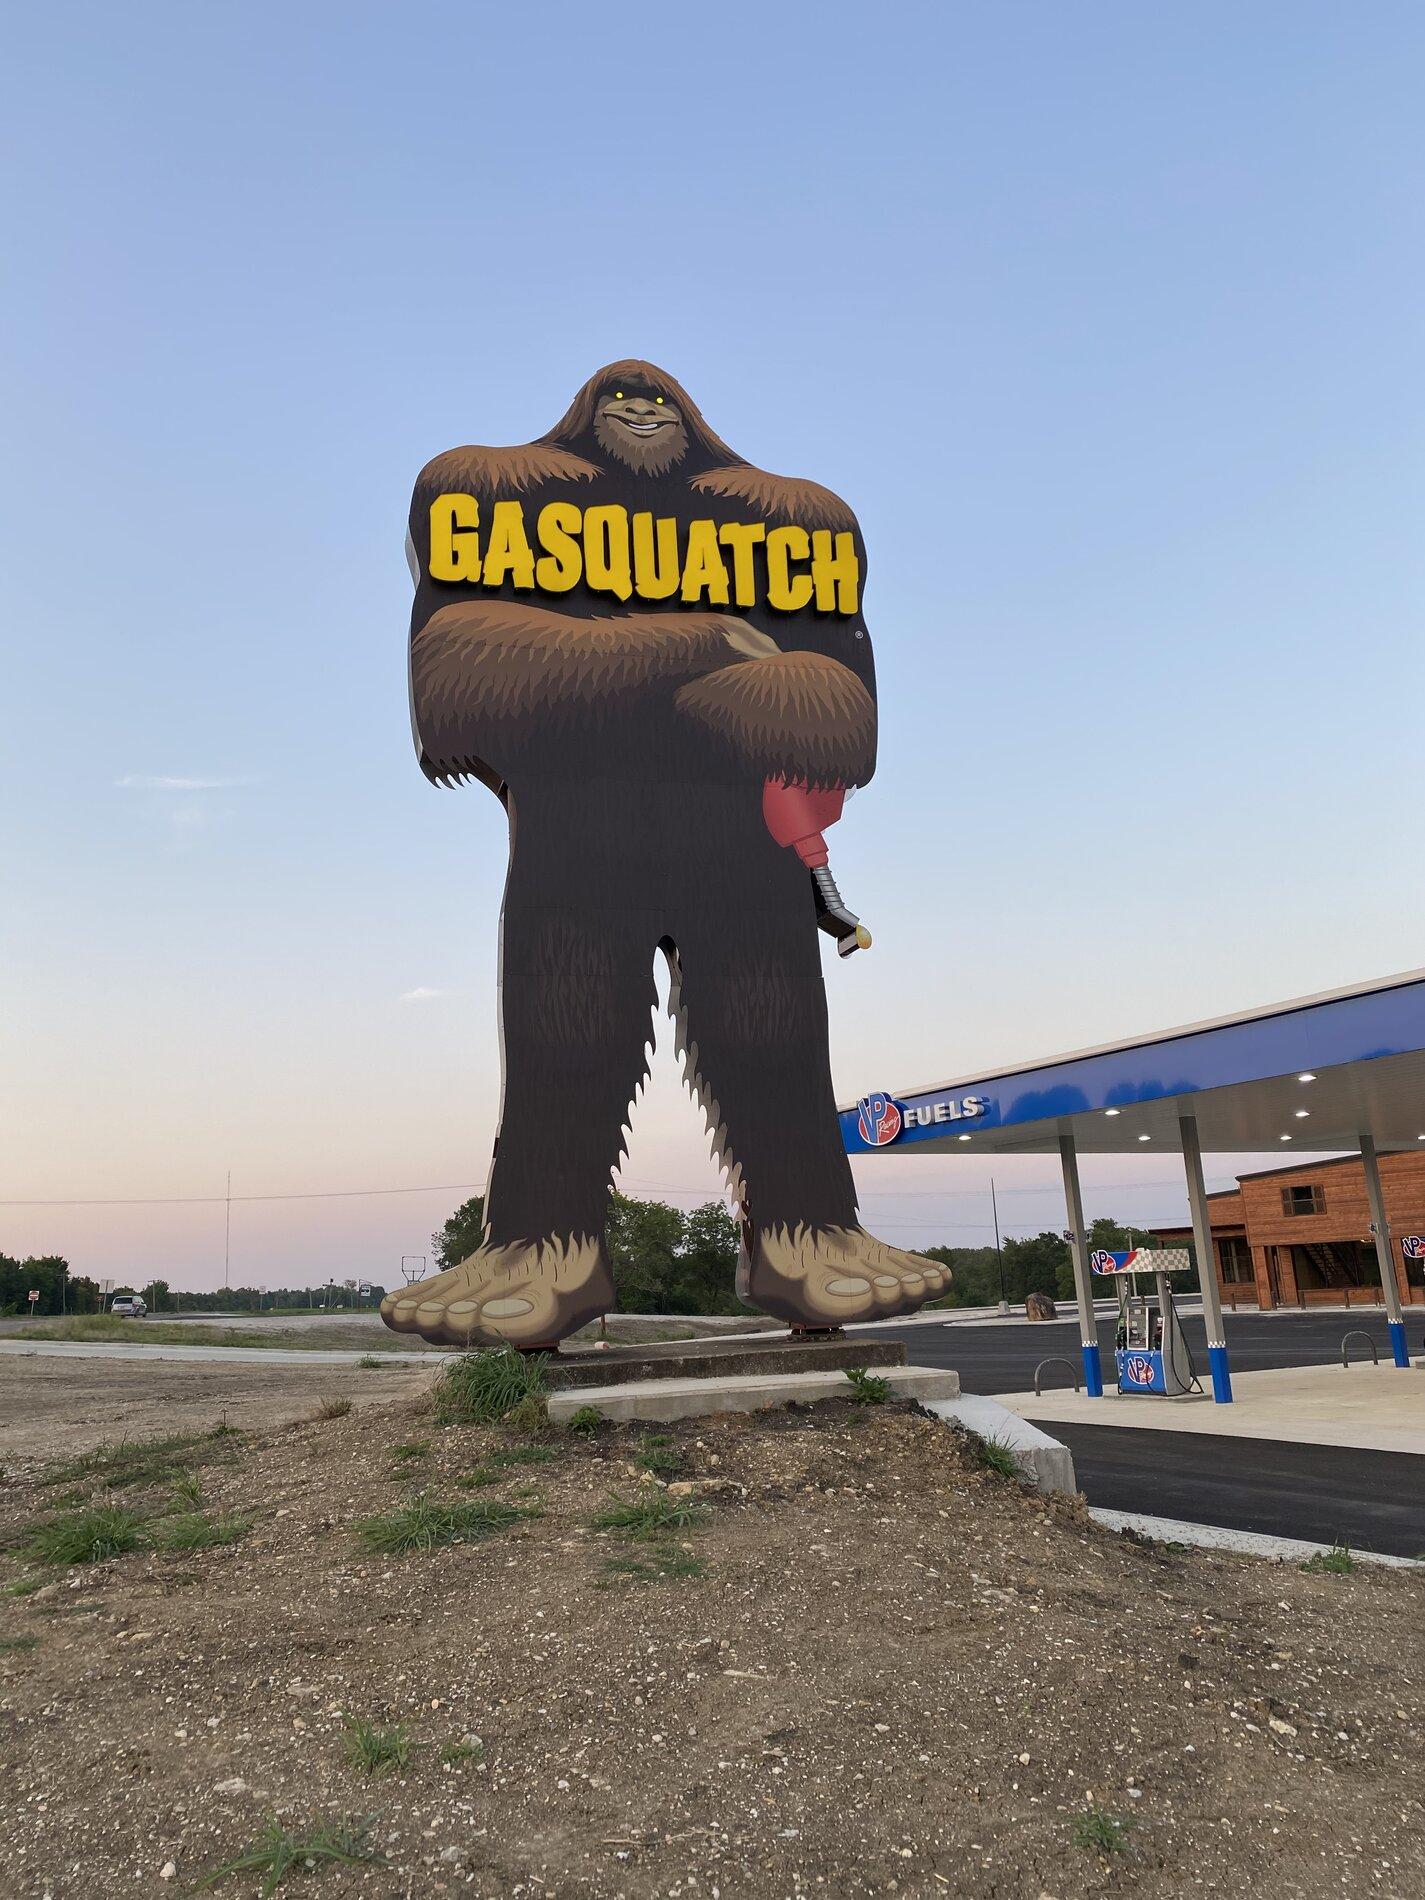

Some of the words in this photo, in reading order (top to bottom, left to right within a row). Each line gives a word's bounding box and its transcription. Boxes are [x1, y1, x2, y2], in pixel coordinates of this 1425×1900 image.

[429, 493, 858, 614] GASQUATCH
[858, 1093, 887, 1144] VP
[904, 1096, 980, 1128] FUELS
[1402, 1236, 1420, 1257] VP
[1091, 1250, 1108, 1274] VP
[1128, 1357, 1145, 1383] VP
